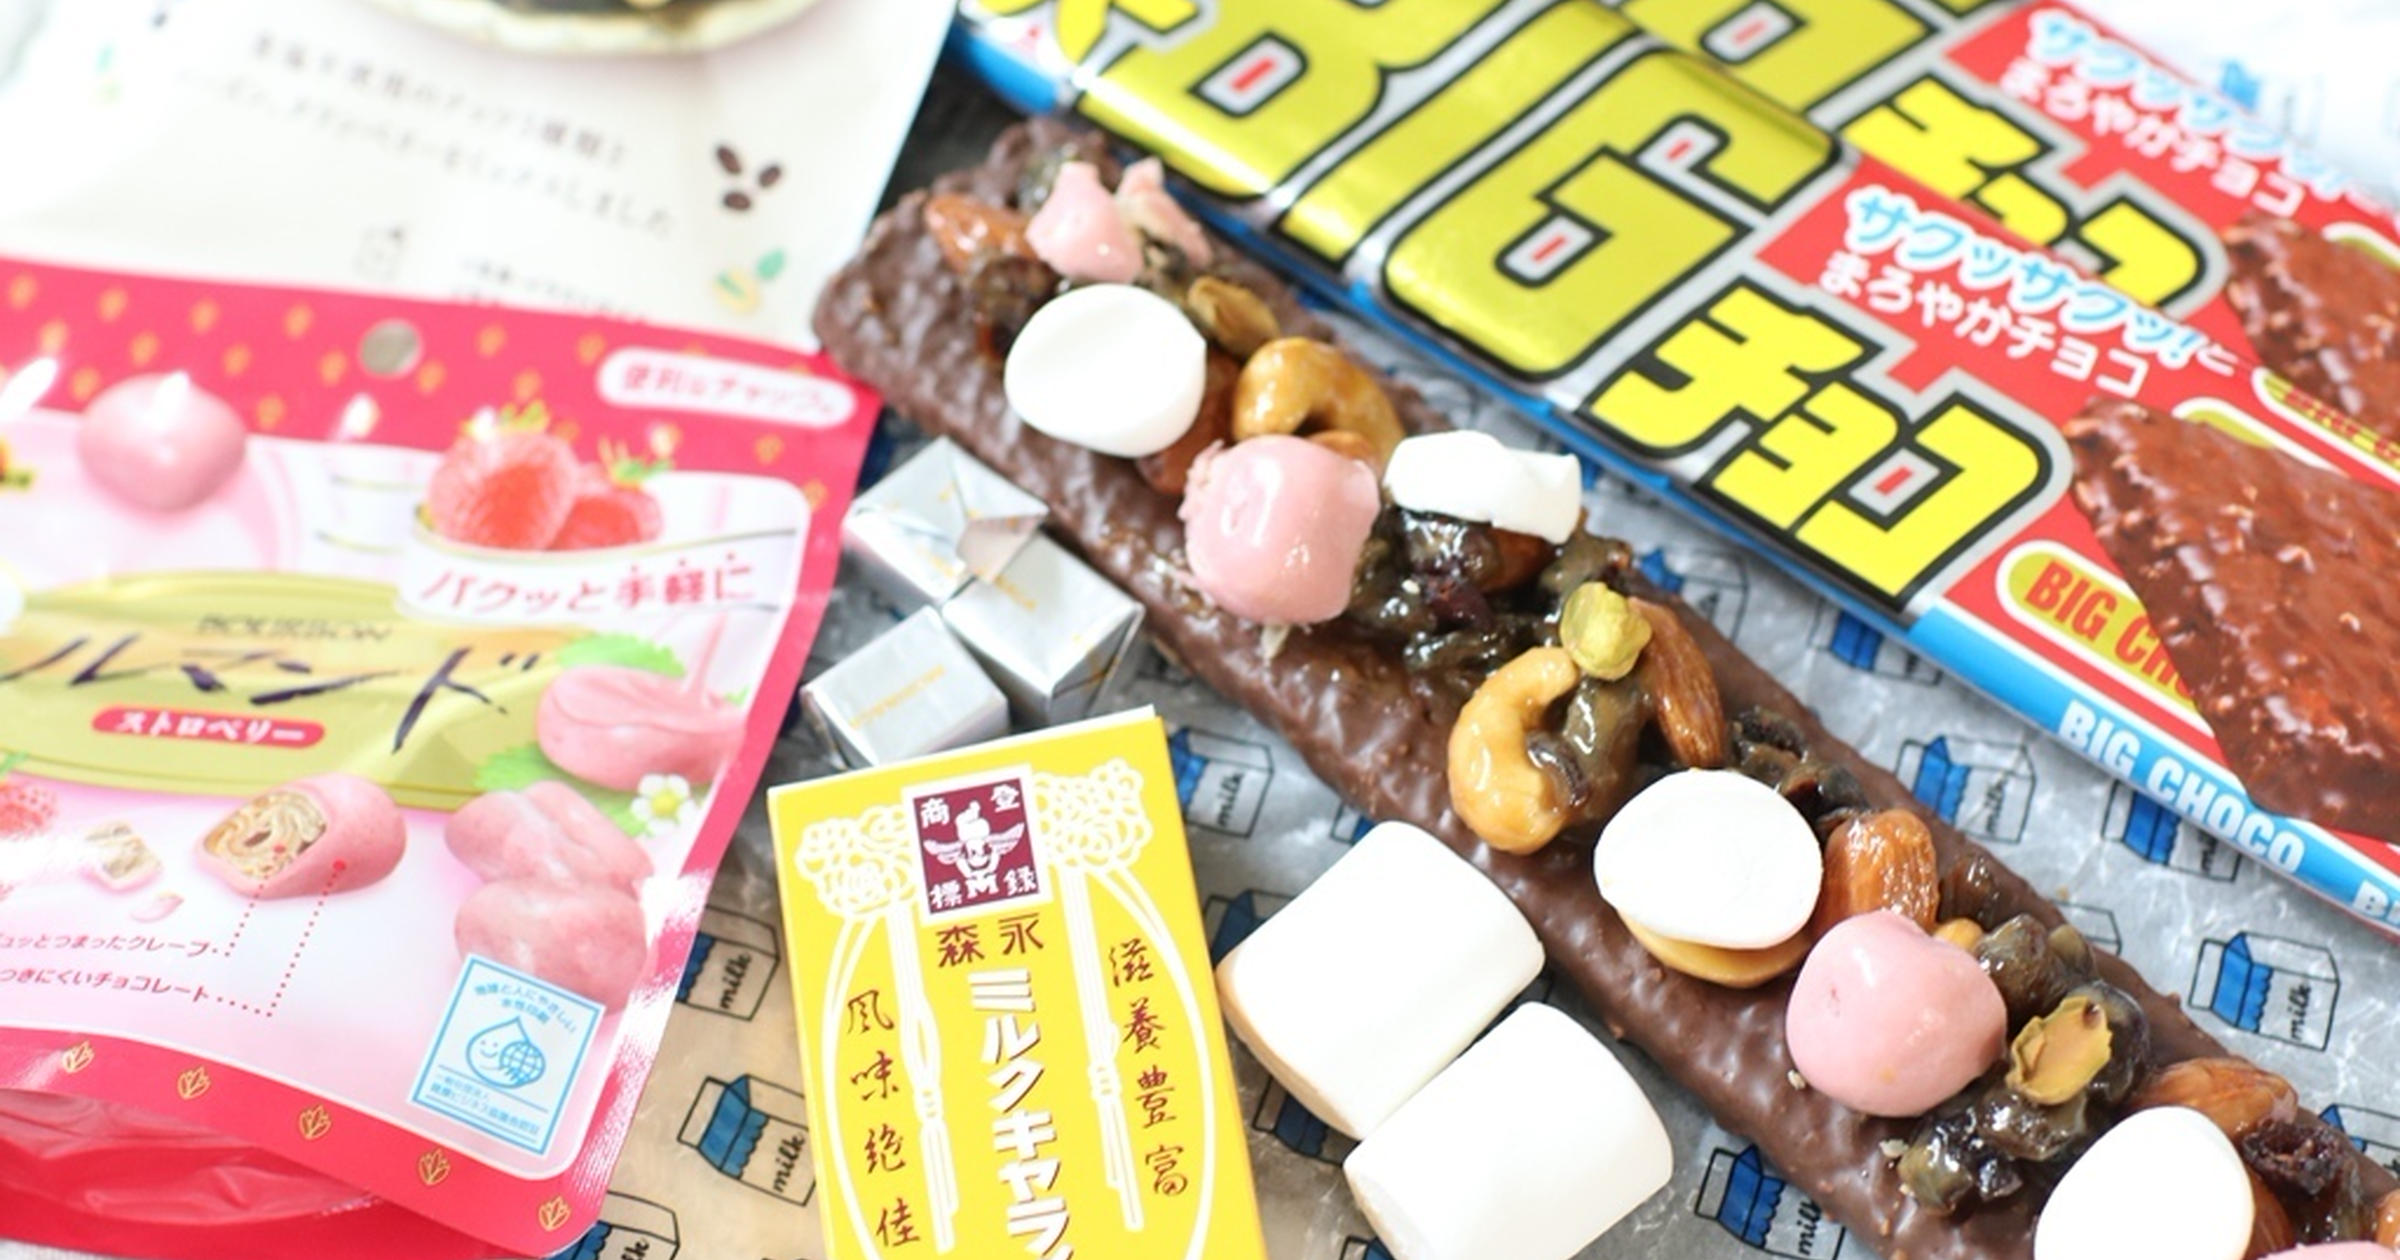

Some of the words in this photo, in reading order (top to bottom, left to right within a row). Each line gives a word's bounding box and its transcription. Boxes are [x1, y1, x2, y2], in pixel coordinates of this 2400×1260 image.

[1819, 251, 2150, 400] まろやかチョコ
[1586, 272, 2052, 608] チョコ
[2024, 560, 2117, 644] BIG
[2058, 699, 2142, 780] BIG
[2146, 755, 2306, 875] CHOCO
[936, 912, 1044, 968] 森永
[720, 954, 752, 1010] milk
[2289, 983, 2311, 1040] milk
[967, 968, 1074, 1260] ミルクキャラ
[773, 1133, 806, 1193] milk
[1797, 1200, 1822, 1256] mil
